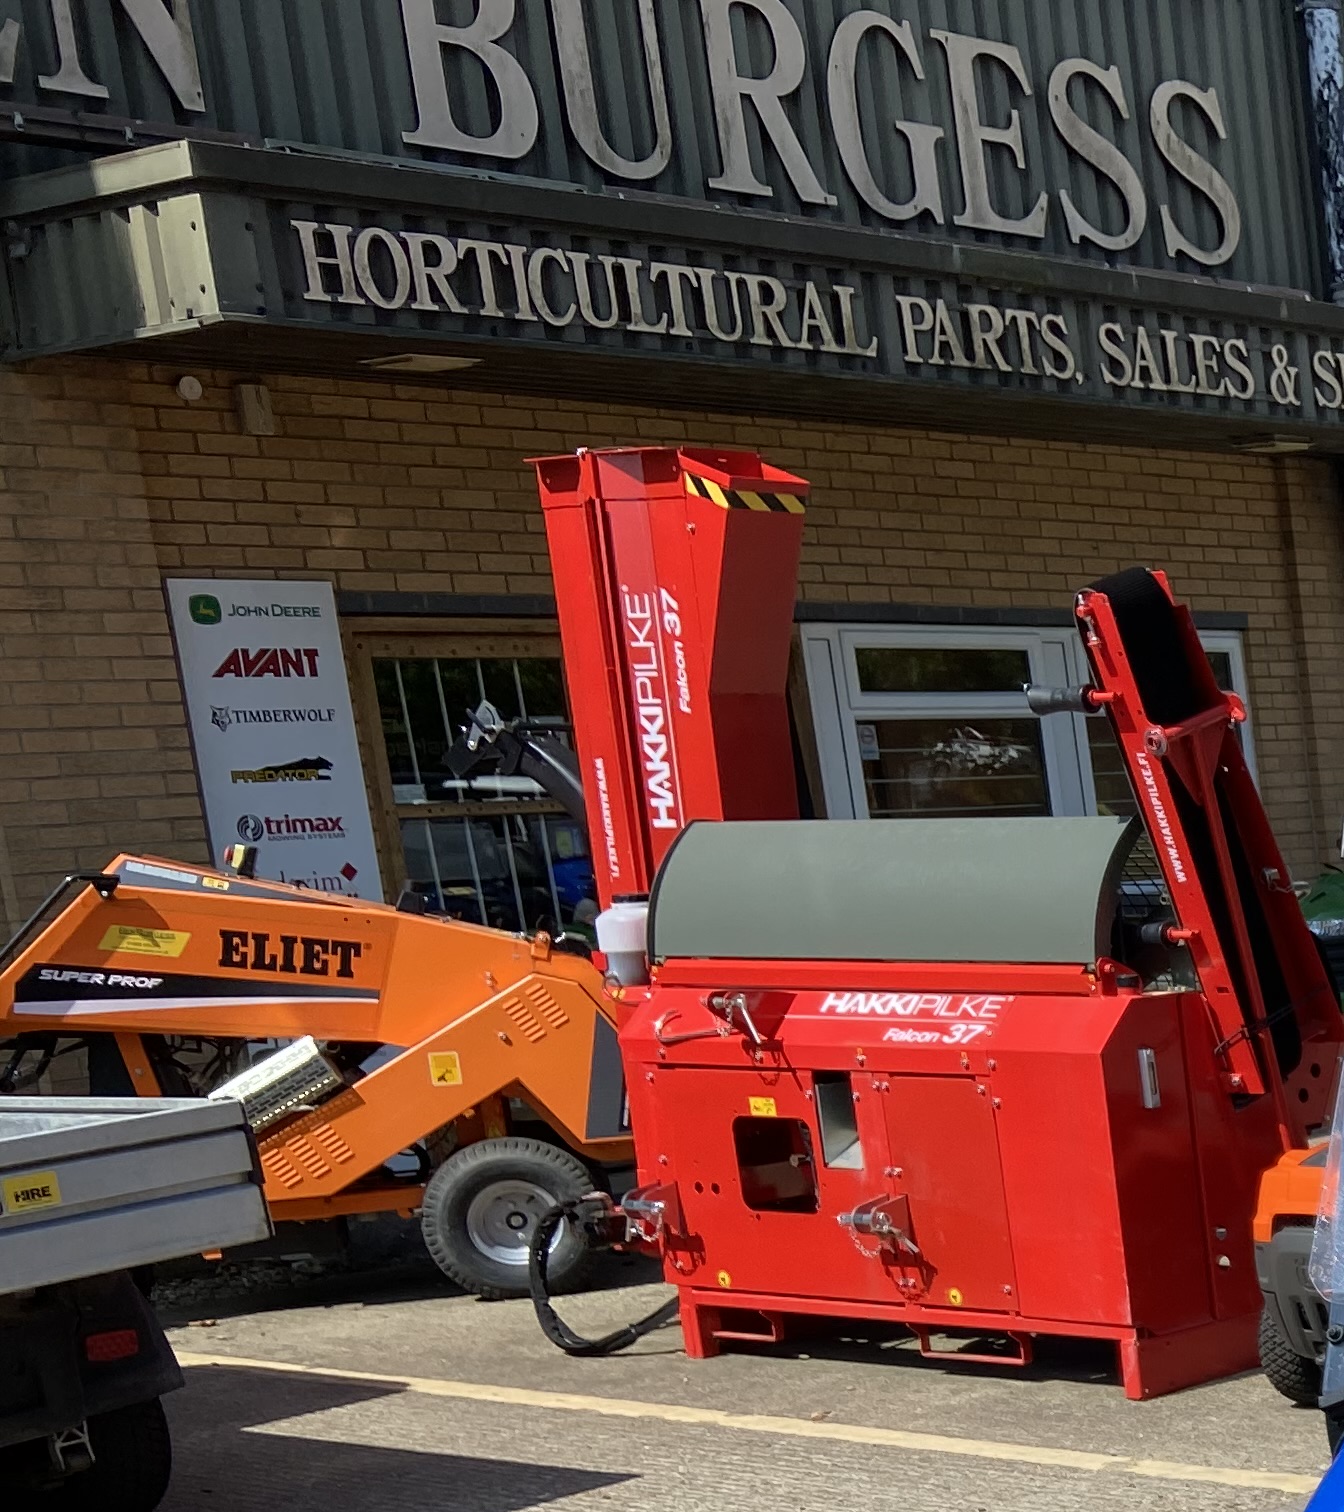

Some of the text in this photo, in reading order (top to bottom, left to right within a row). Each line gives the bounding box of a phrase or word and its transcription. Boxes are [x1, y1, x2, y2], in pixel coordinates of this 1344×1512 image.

[401, 0, 1241, 266] BURGESS
[290, 219, 878, 358] HORTICULTURAL
[896, 295, 1084, 386] PARTS,
[1099, 322, 1256, 400] SALES
[1270, 344, 1301, 406] &
[228, 603, 321, 618] JOHN DEERE
[660, 588, 692, 714] Falcon 37
[212, 648, 320, 678] AVANT
[232, 708, 336, 724] TIMBERWOLF
[624, 591, 678, 829] HAKKIPILKE
[230, 768, 319, 784] PREDATOR
[264, 814, 344, 834] trimax
[219, 929, 362, 979] ELIET
[39, 968, 164, 989] SUPER PROF
[820, 992, 1006, 1018] HAKKIPILKE
[883, 1024, 988, 1044] Falcon 37
[14, 1186, 52, 1203] HIRE
